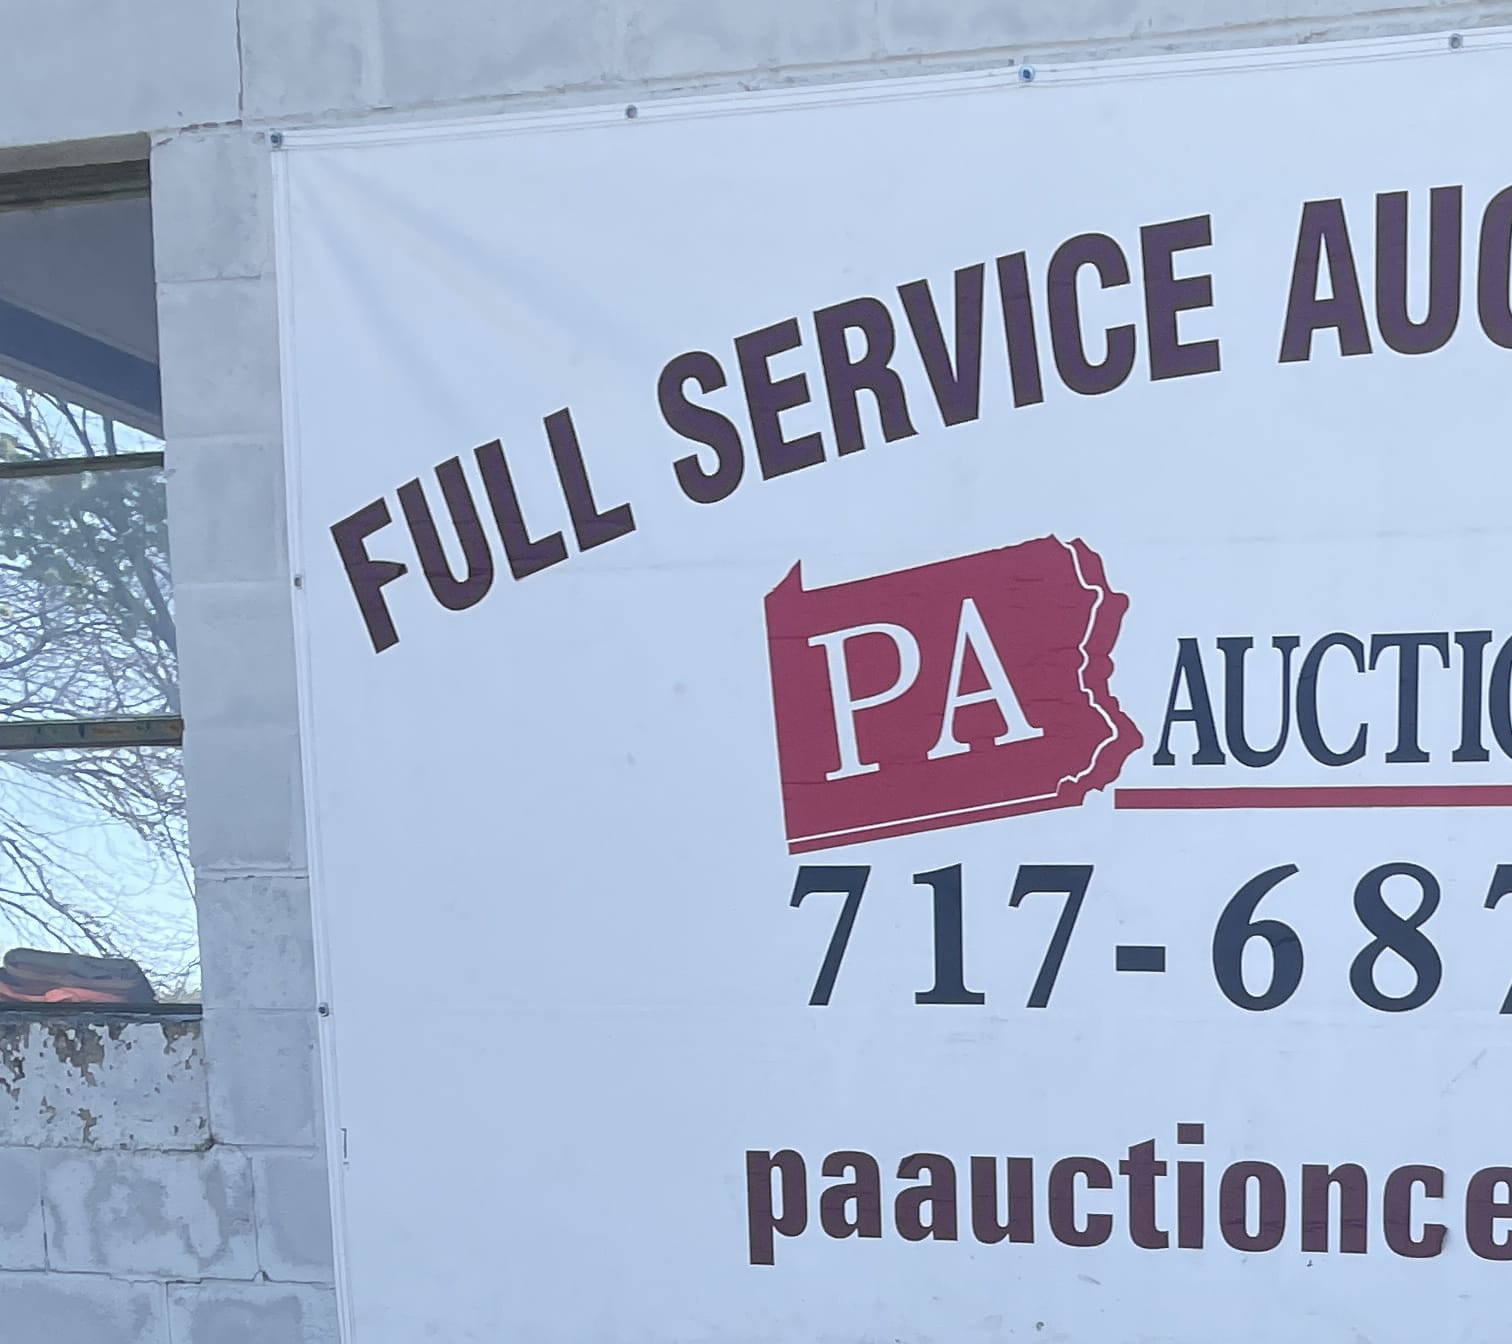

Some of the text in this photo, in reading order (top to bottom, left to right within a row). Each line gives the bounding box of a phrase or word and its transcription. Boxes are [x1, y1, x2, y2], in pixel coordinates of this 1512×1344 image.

[330, 407, 636, 654] FULL
[657, 213, 1221, 505] SERVICE
[808, 597, 1044, 781] PA
